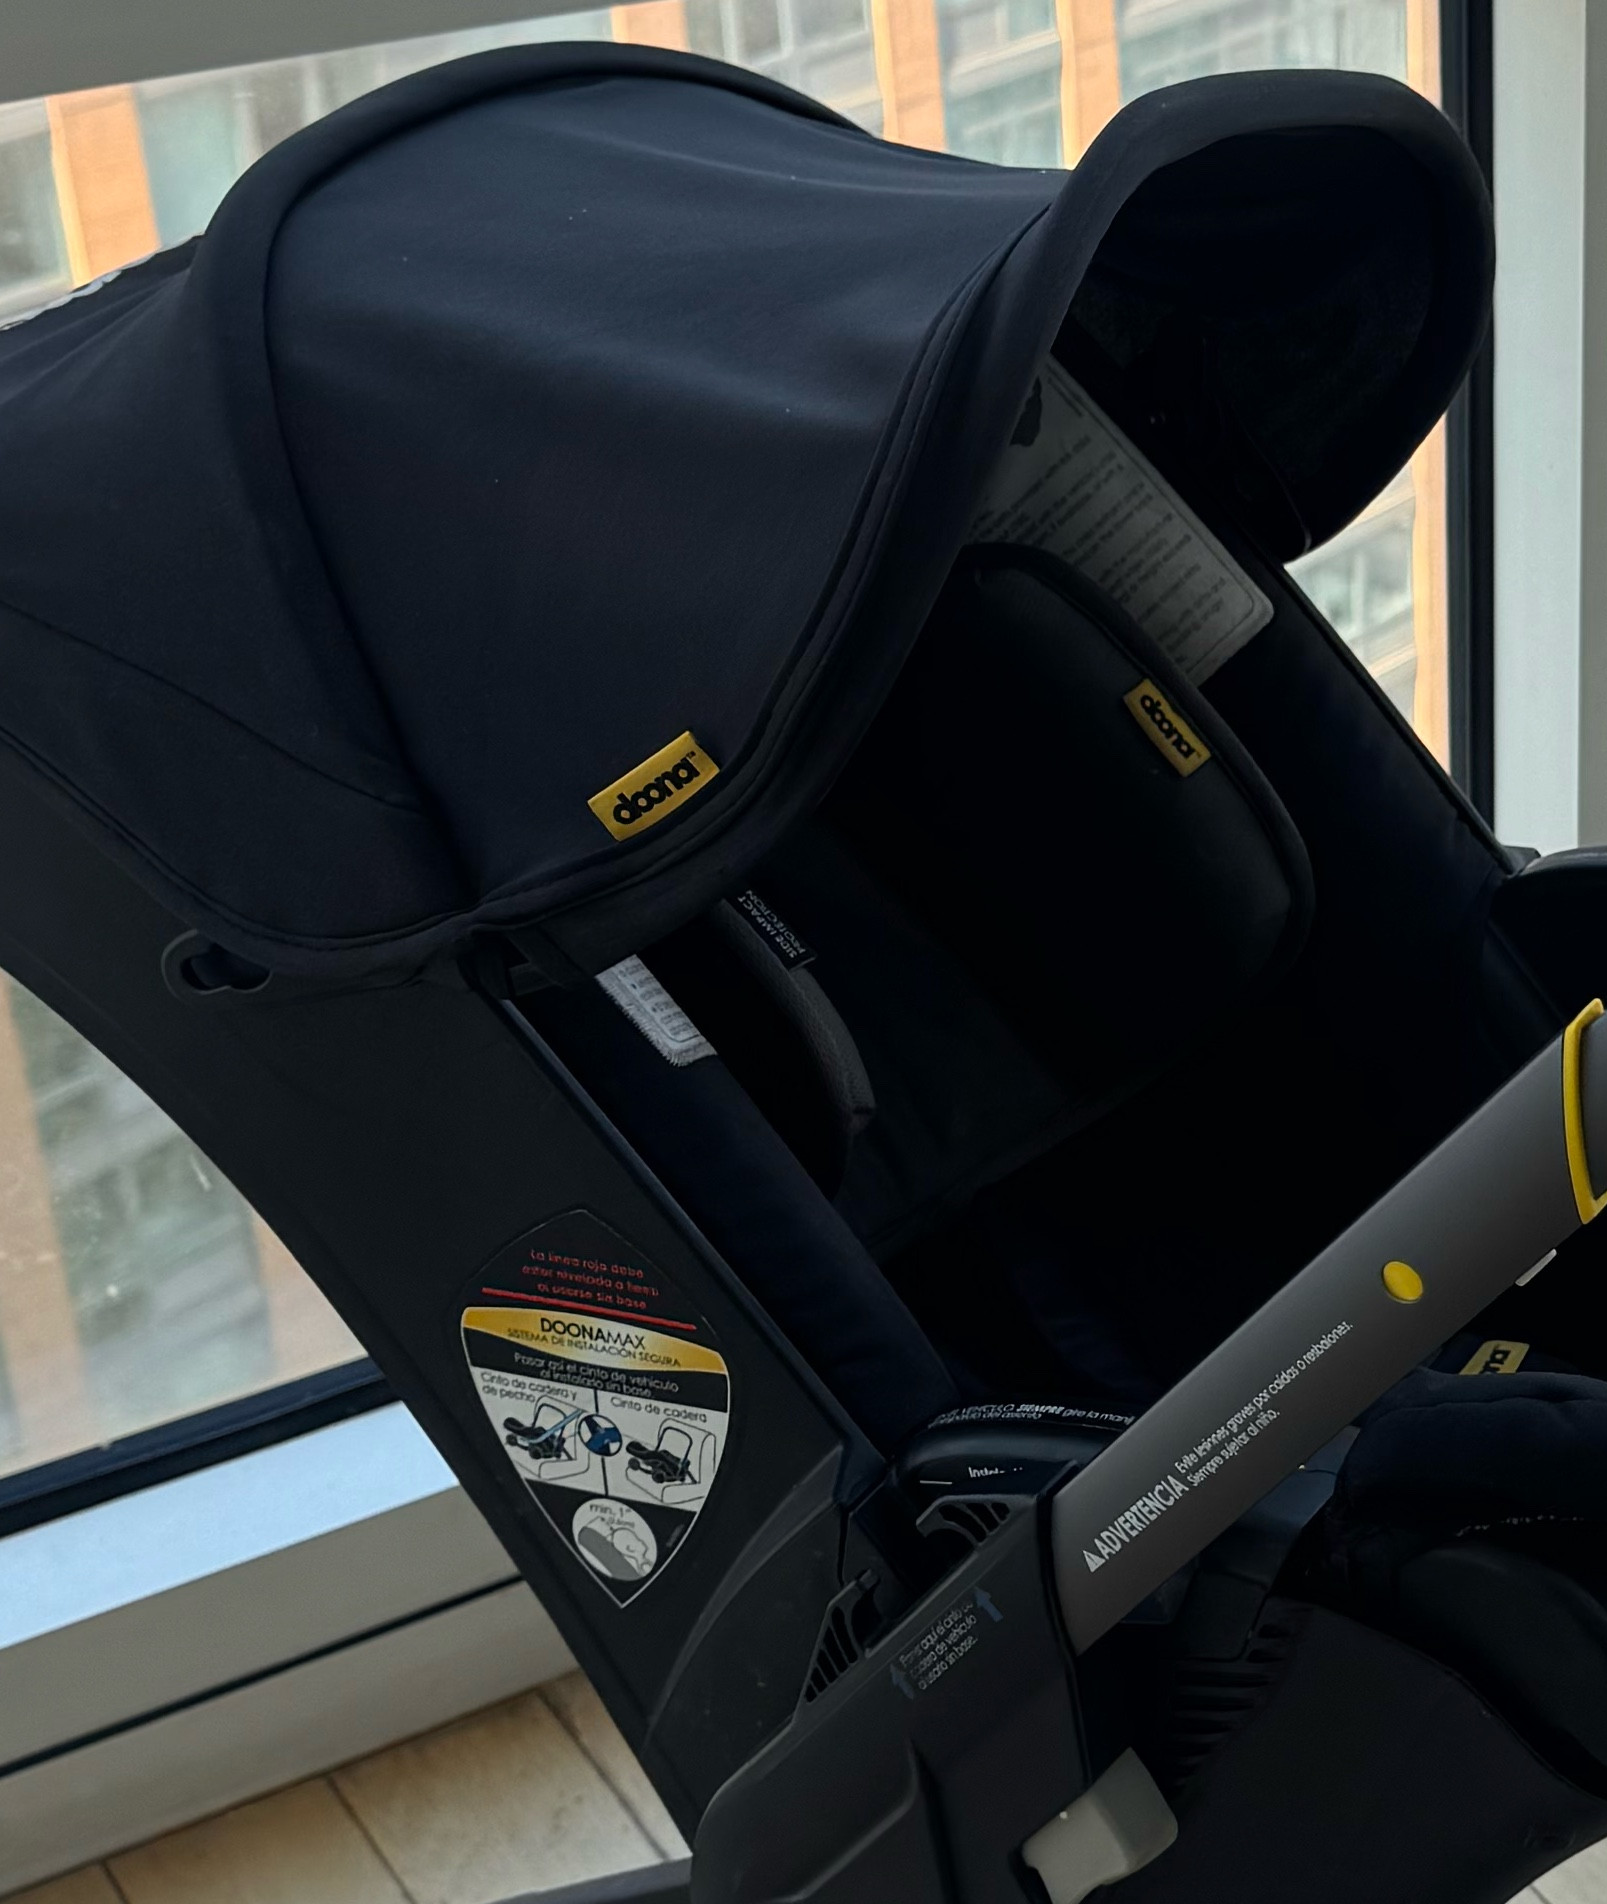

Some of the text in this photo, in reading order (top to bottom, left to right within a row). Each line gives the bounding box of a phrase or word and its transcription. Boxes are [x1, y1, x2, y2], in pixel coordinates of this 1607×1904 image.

[1141, 695, 1196, 759] doona
[613, 753, 700, 824] doona
[738, 896, 798, 958] SIDE IMPACT
[507, 1328, 548, 1344] SISTEMA
[551, 1335, 565, 1346] DE
[639, 1351, 681, 1368] SEGURA
[540, 1317, 646, 1351] DOONAMAX
[529, 1381, 567, 1398] cadera
[580, 1364, 608, 1380] cinto
[1226, 1402, 1256, 1436] graves
[1253, 1389, 1271, 1409] por
[1297, 1359, 1307, 1371] o
[611, 1396, 707, 1424] Cinto de cadera
[1187, 1457, 1224, 1487] Siempre
[1247, 1423, 1259, 1437] al
[1094, 1475, 1189, 1560] ADVERTENCIA
